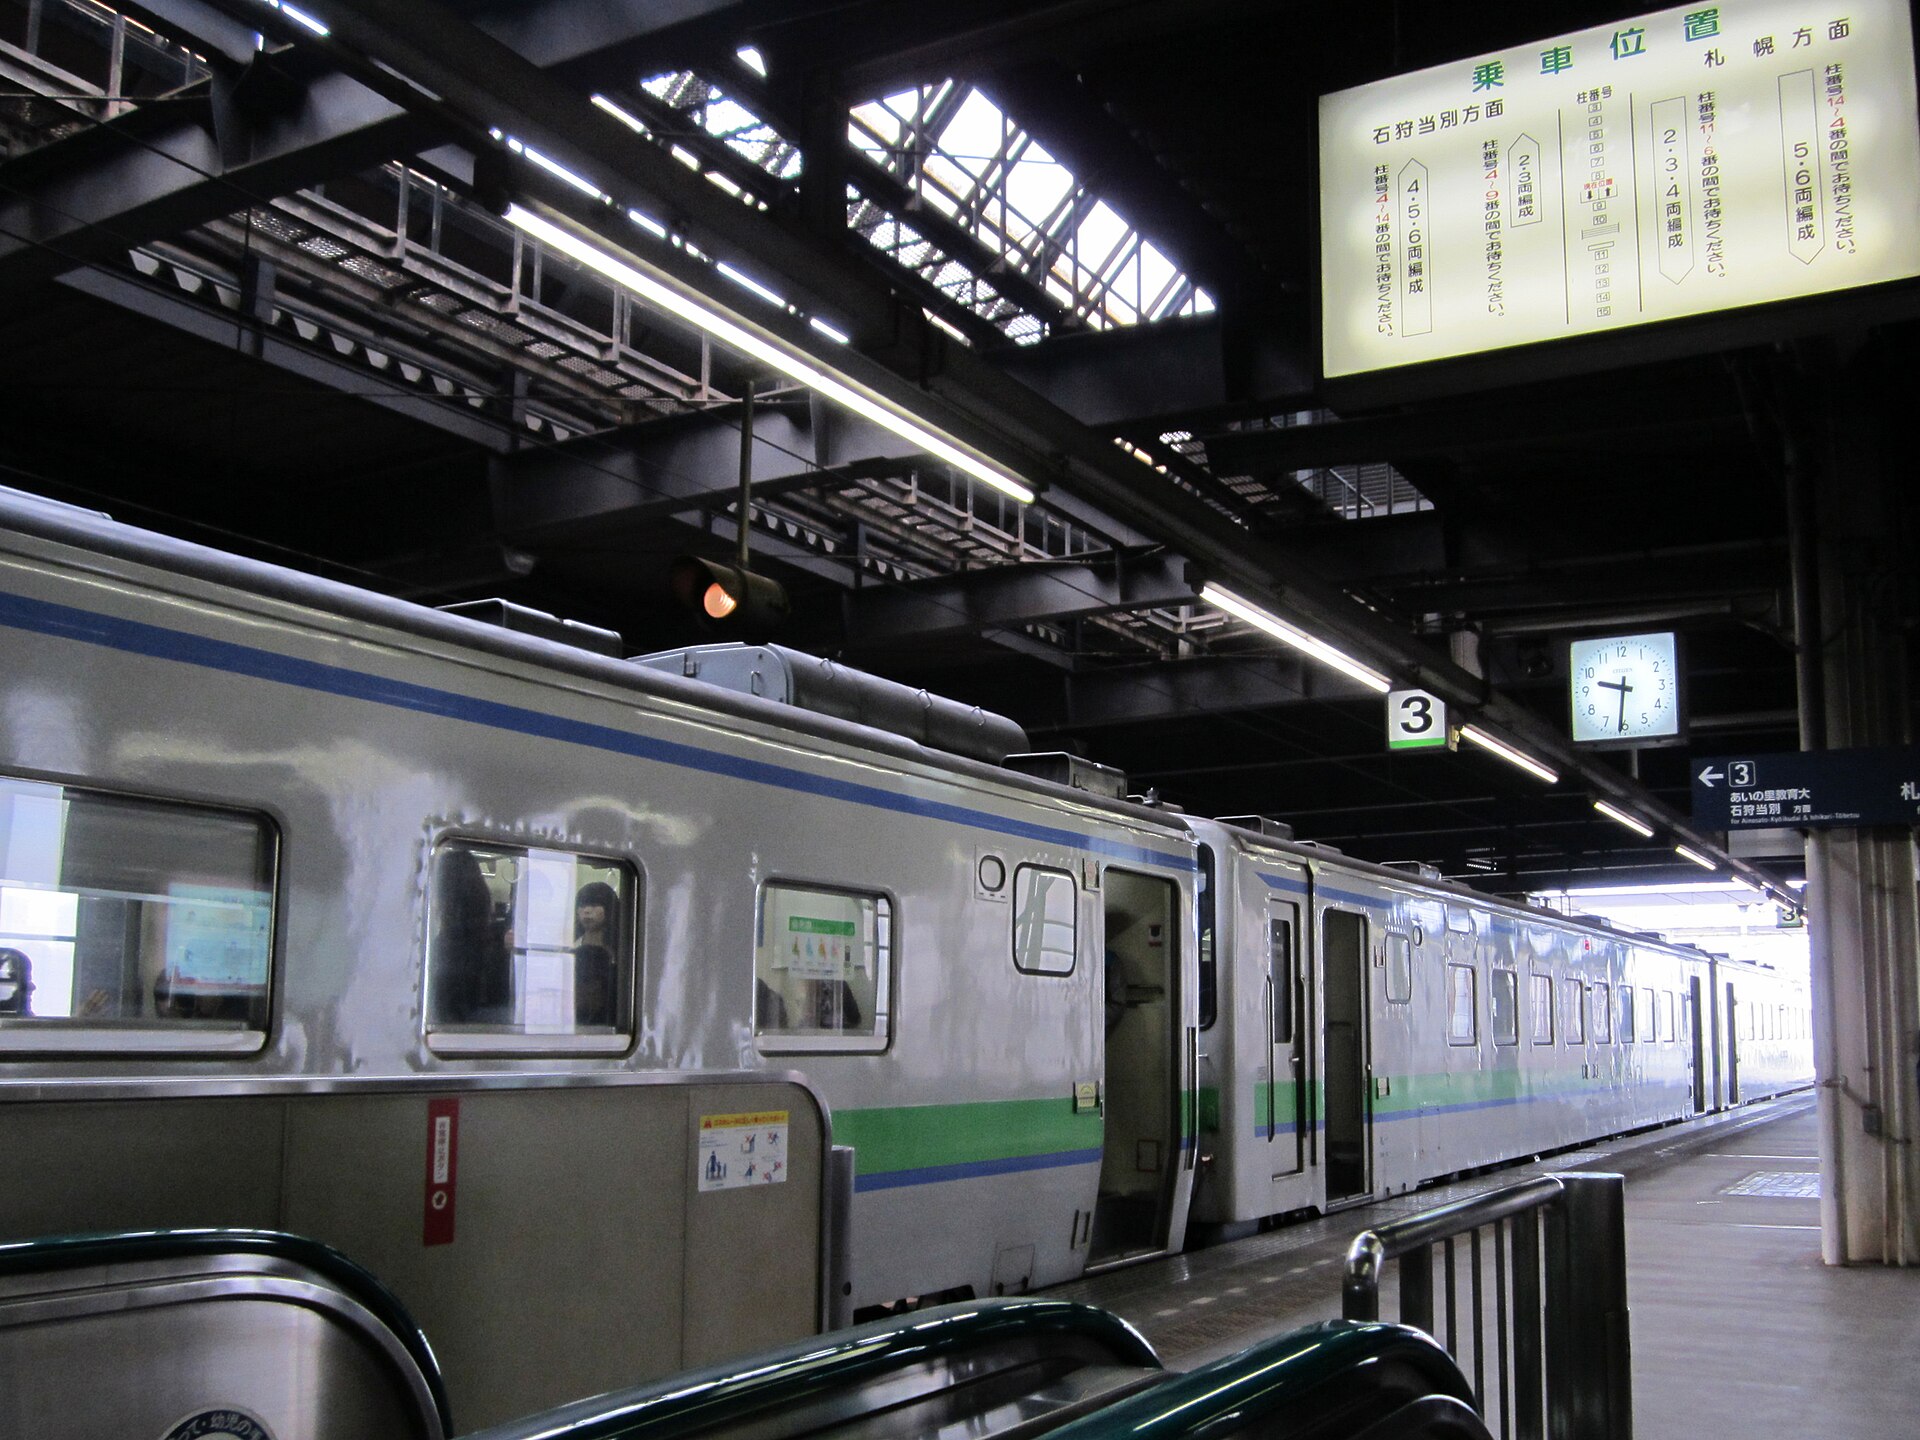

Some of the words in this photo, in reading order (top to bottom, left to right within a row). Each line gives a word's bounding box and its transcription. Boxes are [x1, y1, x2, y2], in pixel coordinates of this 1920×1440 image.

[1703, 17, 1850, 69] 札幌方面
[1472, 8, 1721, 93] 乗車位置
[1576, 85, 1612, 104] 柱番号
[1372, 98, 1504, 145] 石狩当別方面
[1616, 646, 1627, 658] 12
[1599, 653, 1608, 664] 11
[1653, 661, 1659, 672] 2
[1585, 667, 1595, 679] 10
[1658, 679, 1665, 690] 3
[1582, 686, 1589, 697] 9
[1588, 704, 1595, 715] 8
[1654, 698, 1661, 709] 4
[1400, 696, 1433, 734] 3
[1641, 712, 1648, 724] 5
[1603, 716, 1609, 727] 7
[1622, 719, 1629, 731] 6
[1735, 764, 1750, 785] 3
[1730, 788, 1811, 803] あいの里教育大
[1900, 782, 1920, 801] 札
[1730, 803, 1781, 817] 石狩当別
[1793, 804, 1811, 814] 方面
[1730, 817, 1740, 825] for
